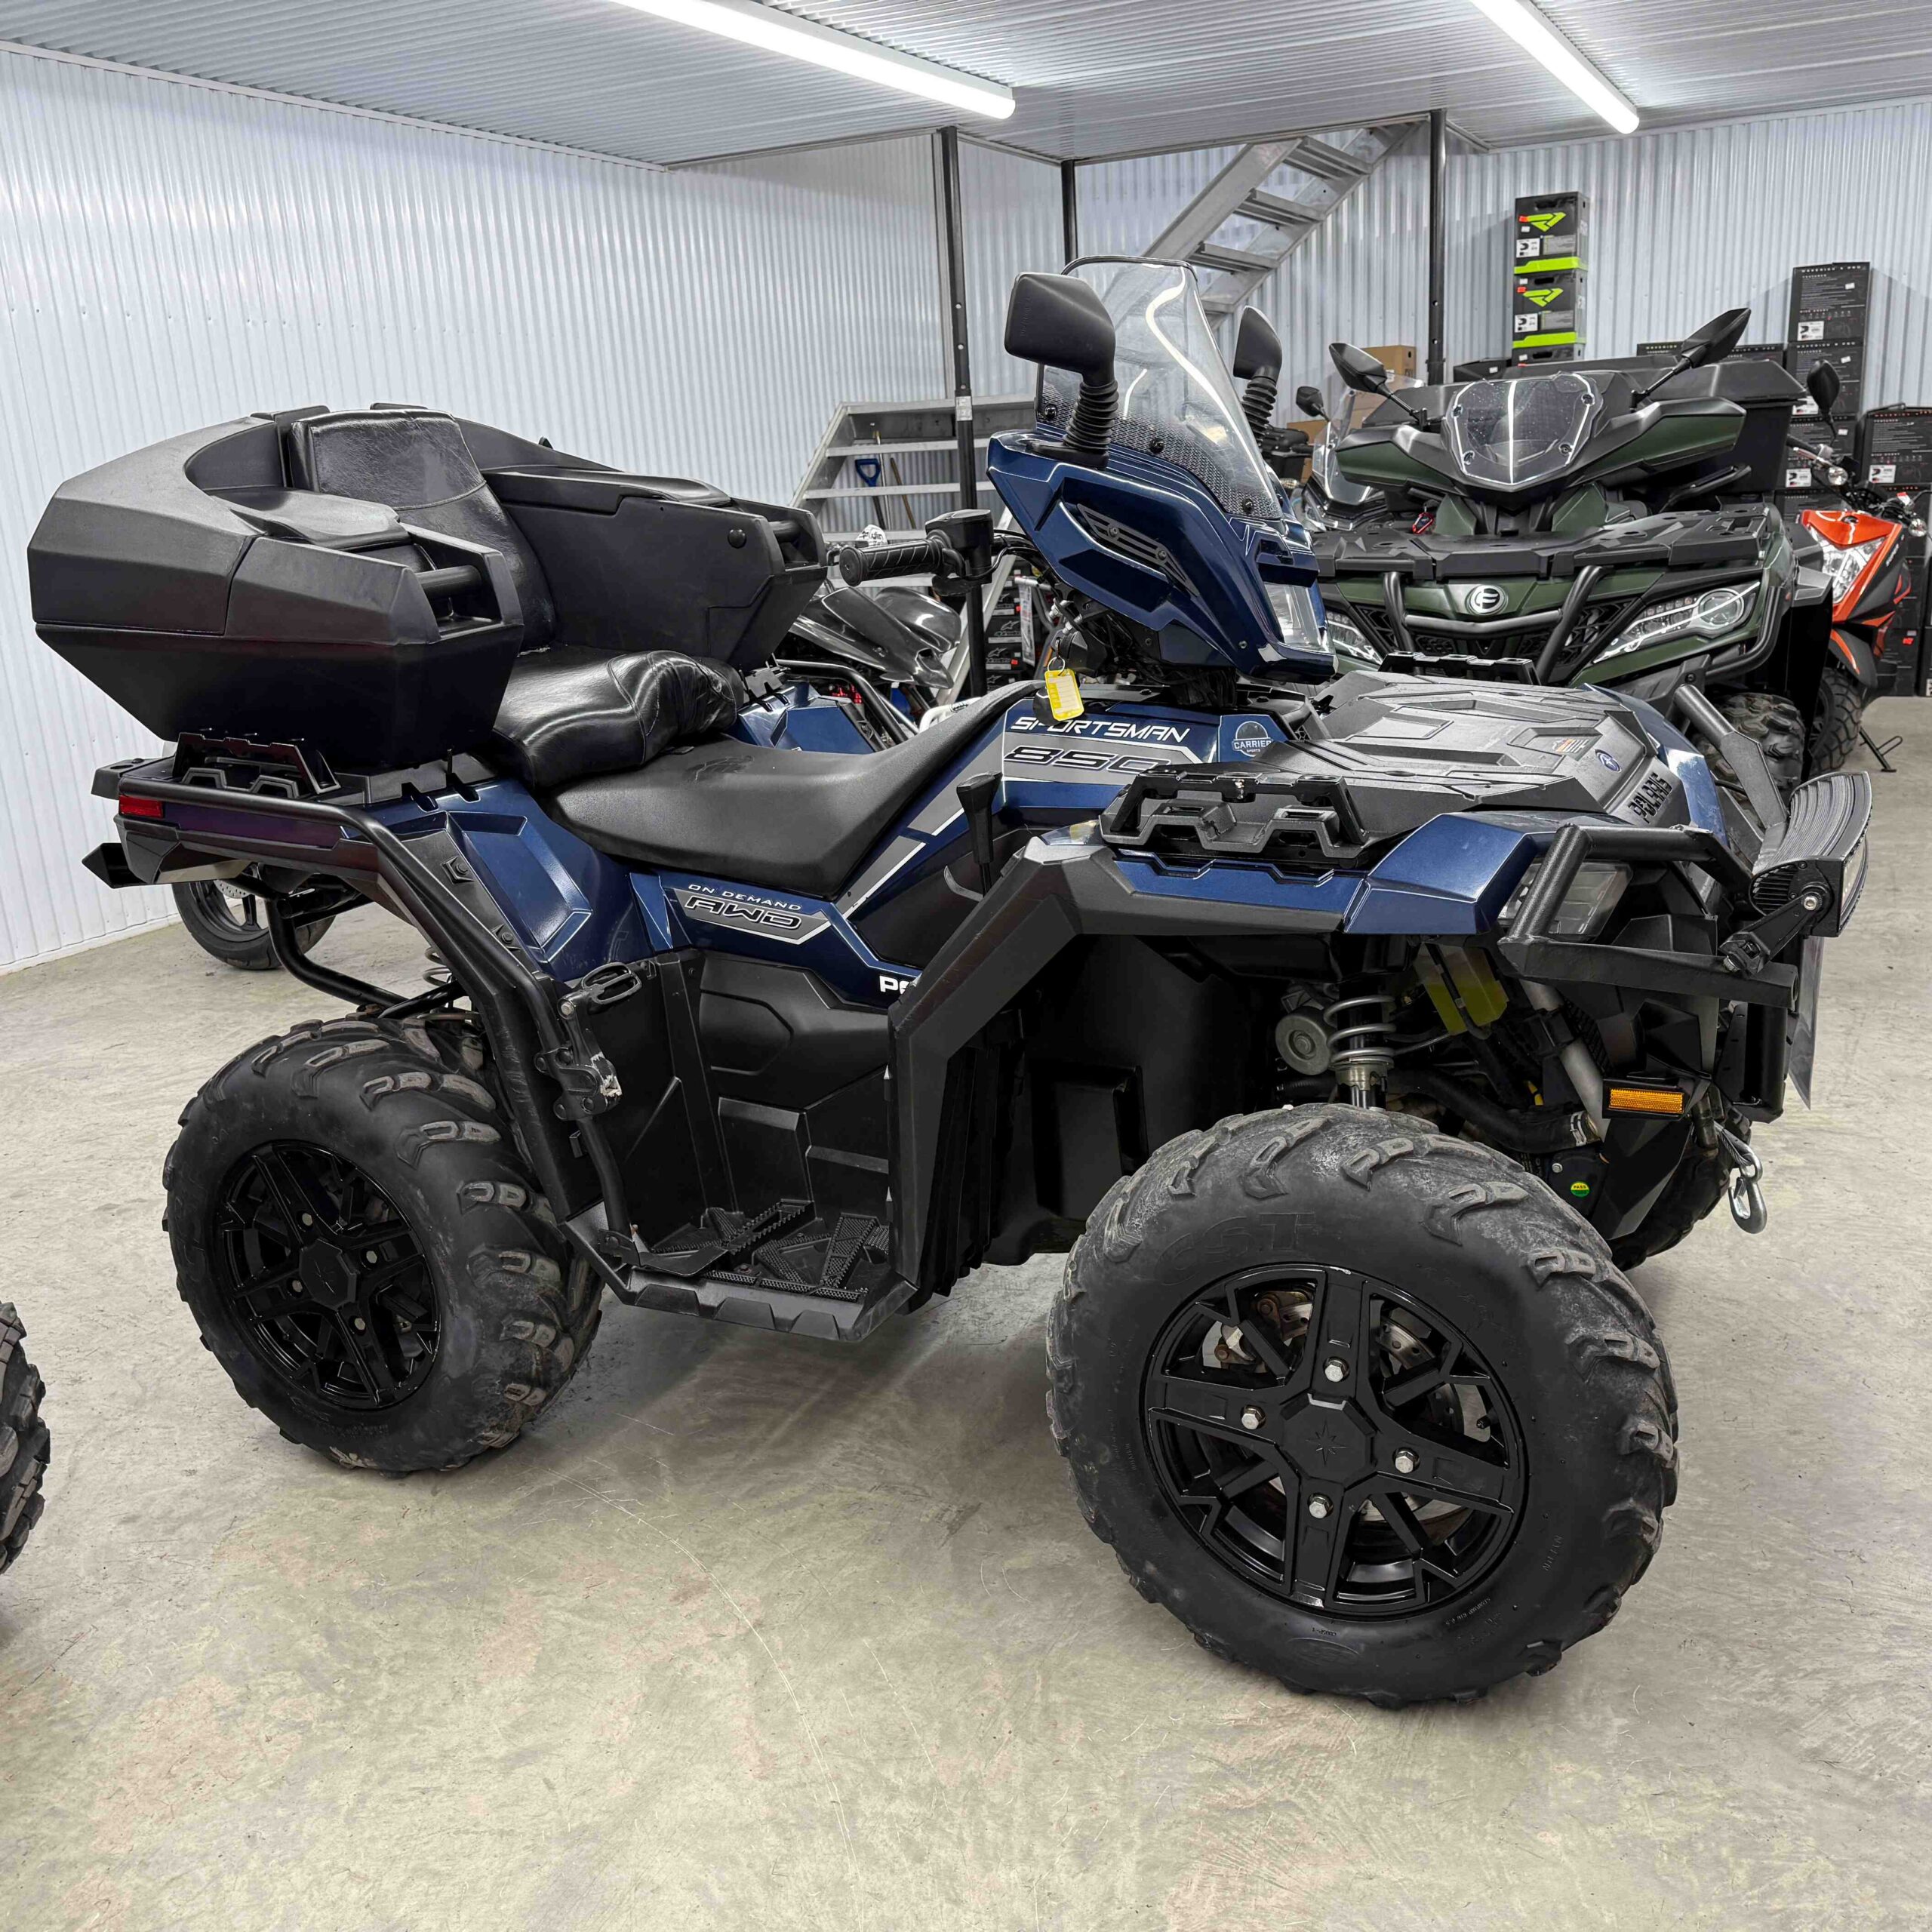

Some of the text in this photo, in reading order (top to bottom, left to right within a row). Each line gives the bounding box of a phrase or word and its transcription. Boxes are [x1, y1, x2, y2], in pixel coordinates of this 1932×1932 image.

[1004, 745, 1171, 775] 850
[1628, 772, 1673, 824] POLARIS
[685, 895, 802, 930] AWD
[688, 884, 802, 911] ON DEMAND
